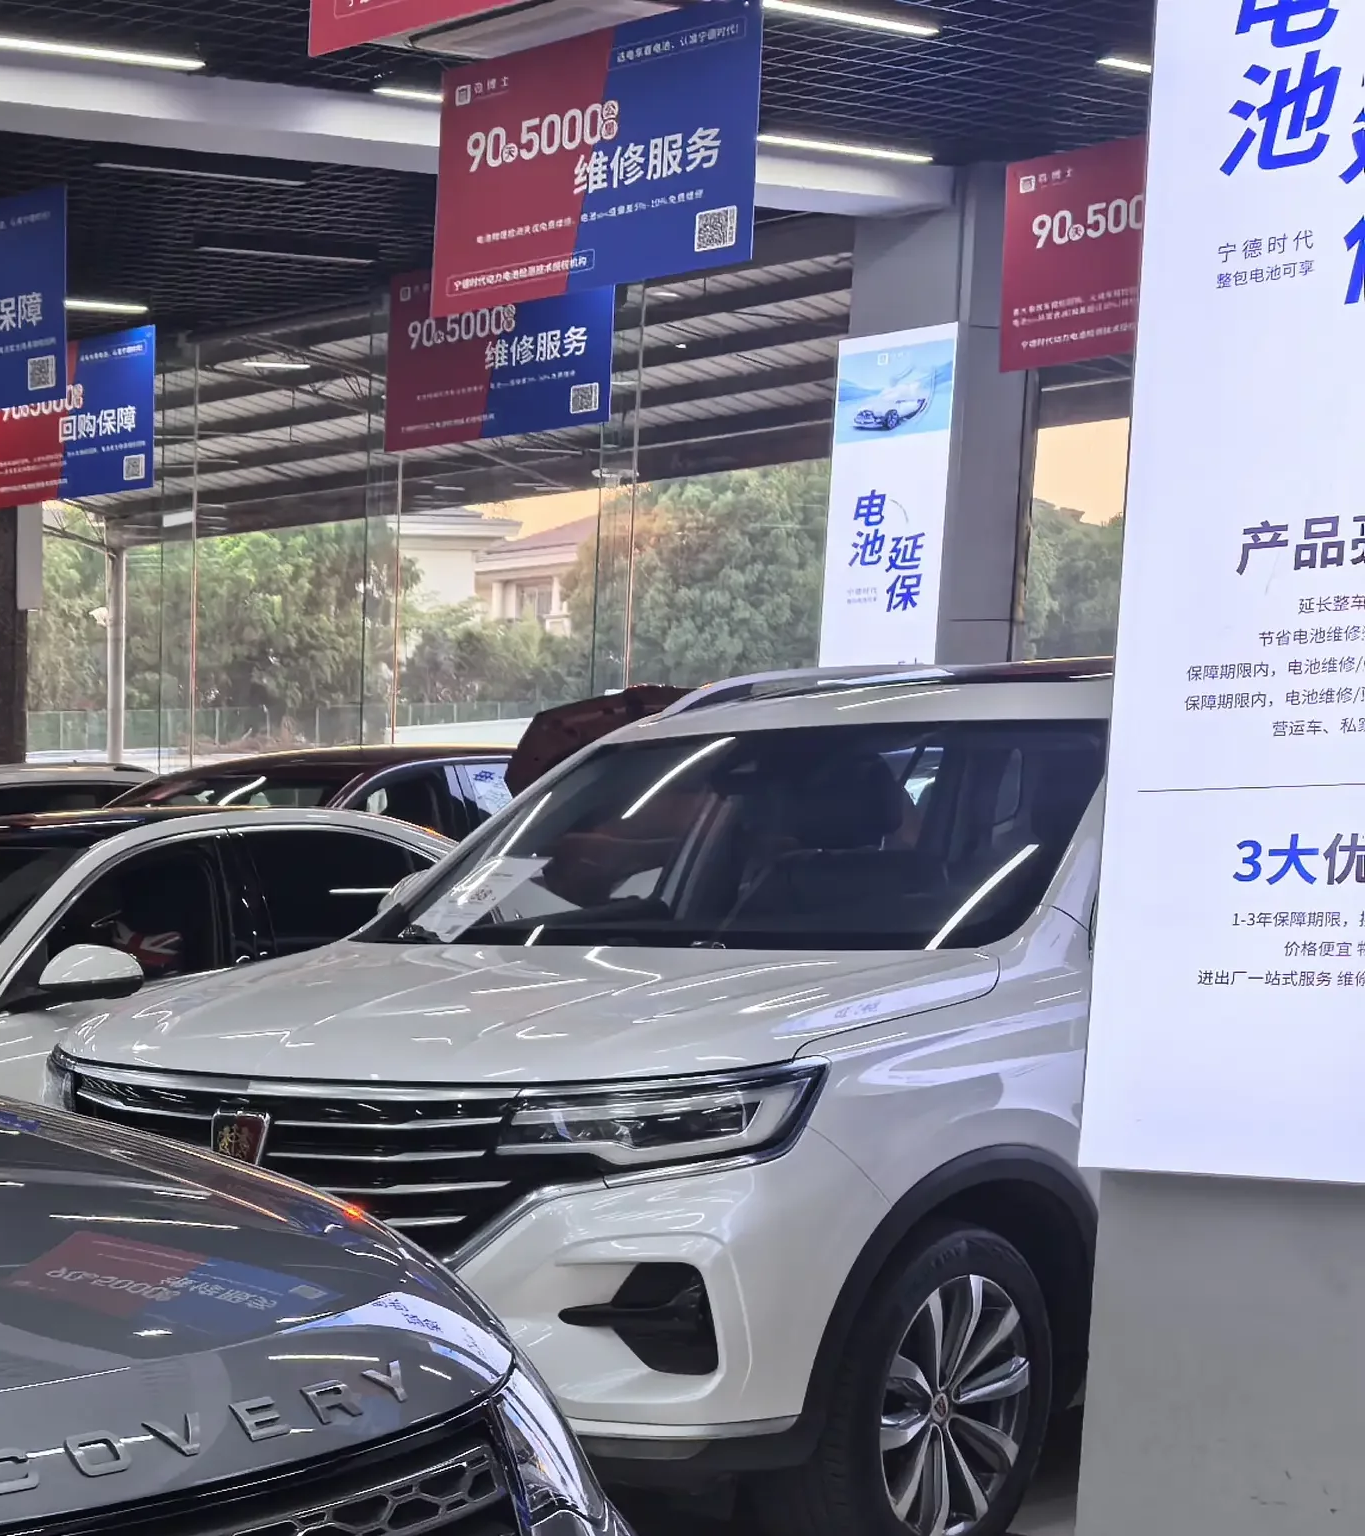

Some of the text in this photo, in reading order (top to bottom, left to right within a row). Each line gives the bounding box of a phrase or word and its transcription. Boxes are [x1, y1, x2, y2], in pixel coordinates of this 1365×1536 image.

[573, 126, 722, 195] 维修服务
[1218, 229, 1314, 263] 宁德时代
[1216, 259, 1315, 290] 整包电池可享
[485, 326, 588, 370] 维修服务
[59, 405, 137, 443] 回购保障
[848, 489, 886, 567] 电池
[885, 532, 925, 613] 延保
[1258, 624, 1365, 647] 节省电池维修
[1186, 655, 1365, 681] 保障期限内，电池维修/
[1184, 686, 1365, 711] 保障期限内，电池维修/
[1232, 832, 1365, 886] 3大优
[1284, 941, 1352, 957] 价格便宜
[1197, 970, 1333, 987] 进出厂一站式服务
